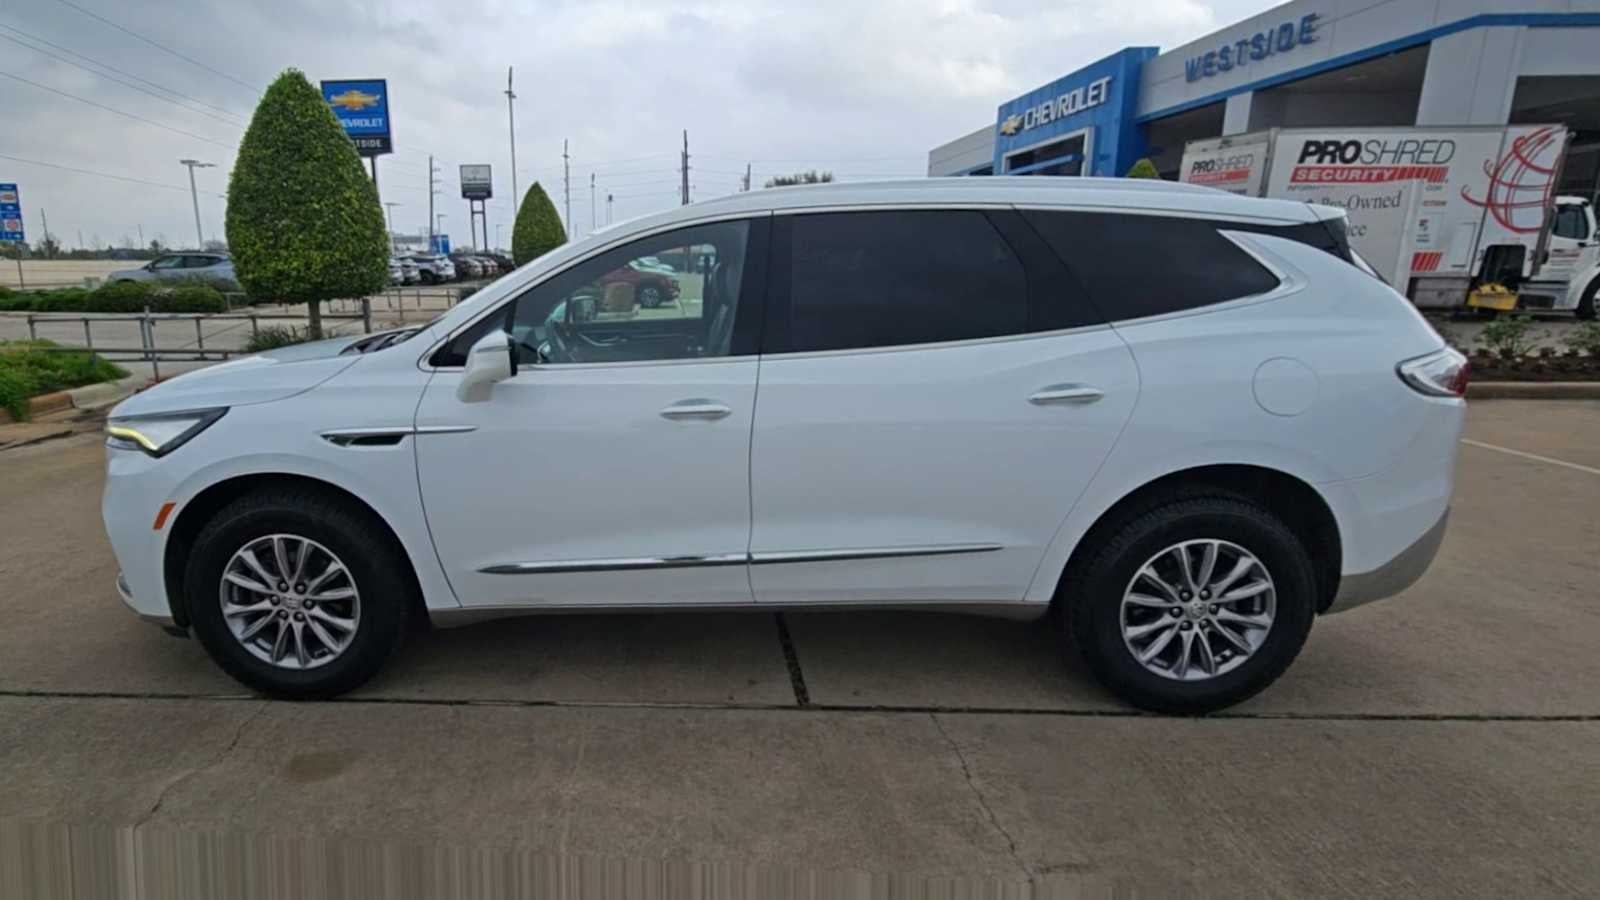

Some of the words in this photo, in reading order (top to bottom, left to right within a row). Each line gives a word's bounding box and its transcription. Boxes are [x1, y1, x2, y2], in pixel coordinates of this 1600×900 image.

[1186, 12, 1319, 82] WESTSIDE
[1024, 76, 1111, 129] CHEVROLET
[341, 117, 383, 128] EVROLET
[354, 138, 383, 148] TSIDE
[1297, 140, 1455, 165] PROSHRED
[1295, 168, 1394, 181] SECURITY
